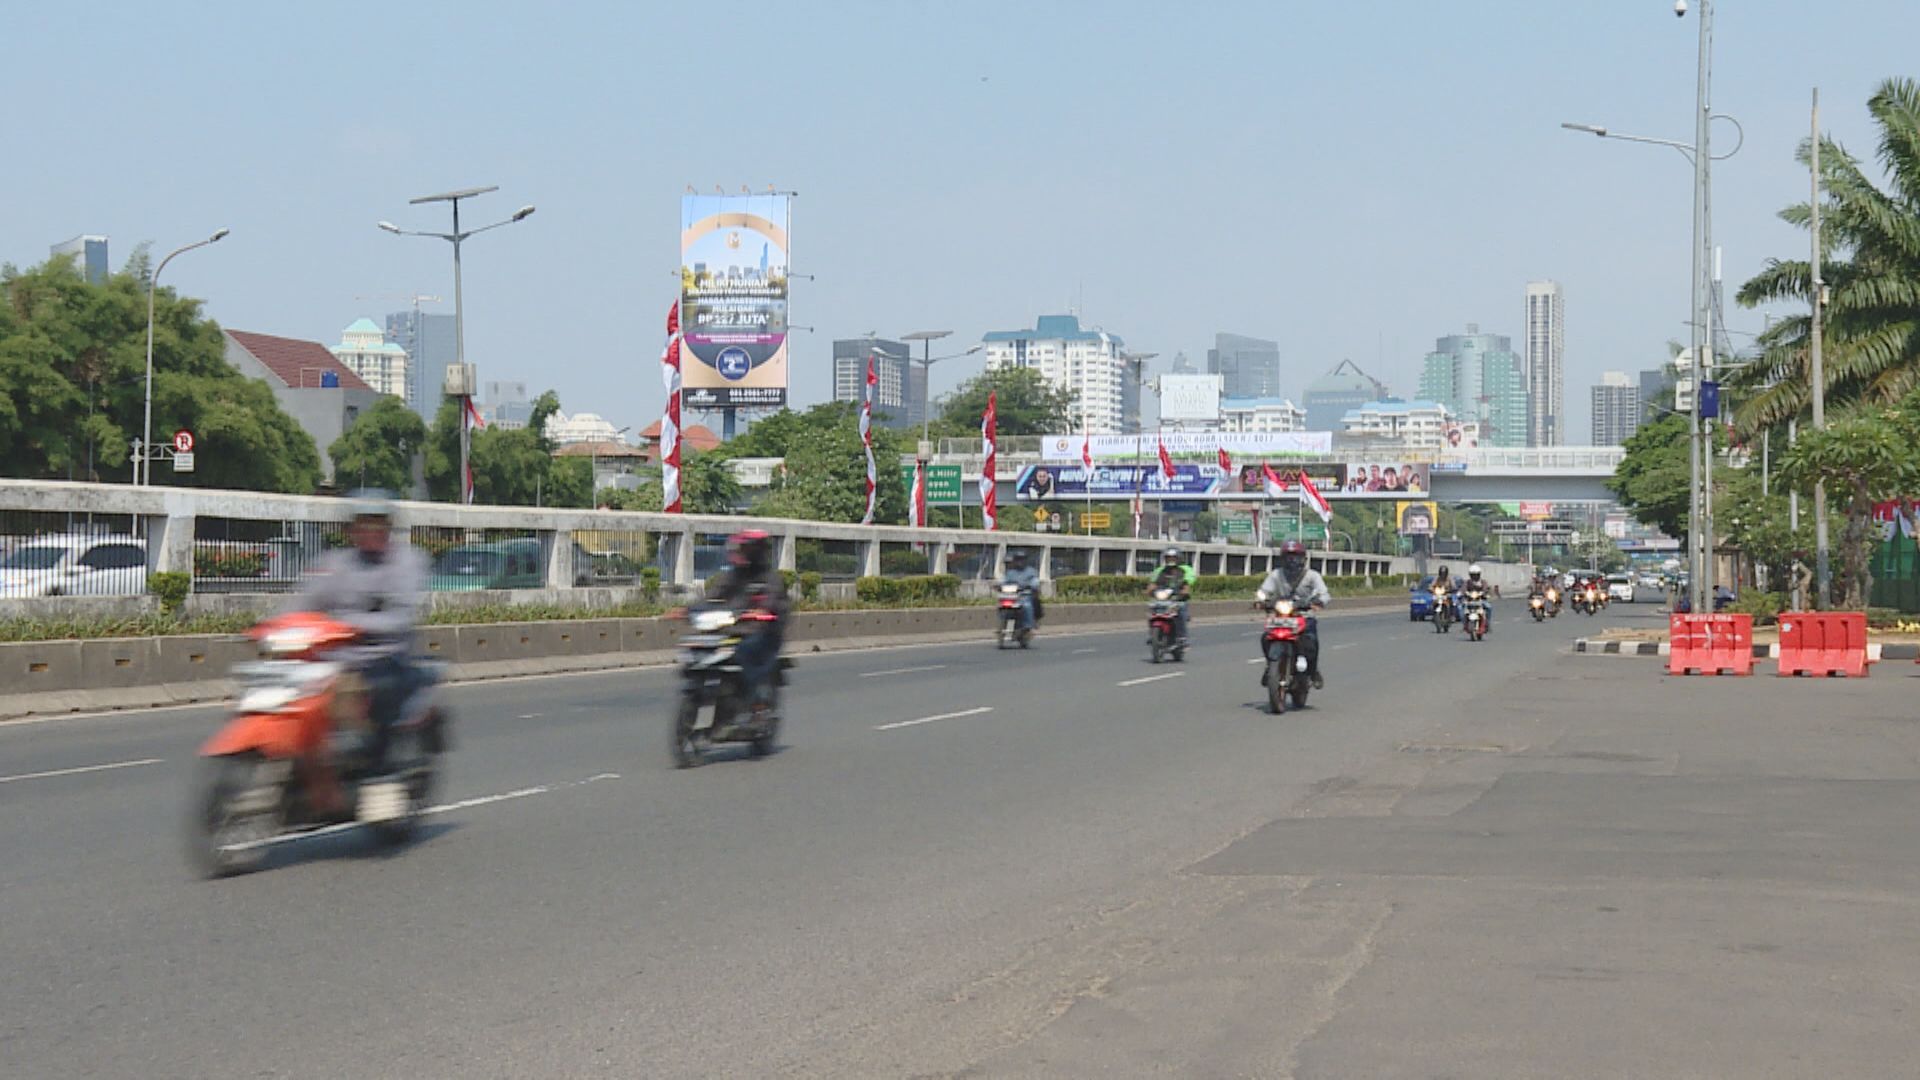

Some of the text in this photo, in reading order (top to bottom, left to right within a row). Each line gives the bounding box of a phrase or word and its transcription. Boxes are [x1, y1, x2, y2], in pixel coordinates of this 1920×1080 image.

[1097, 437, 1129, 446] SELAMAT
[1132, 437, 1150, 445] HRI
[1255, 435, 1275, 443] 2017
